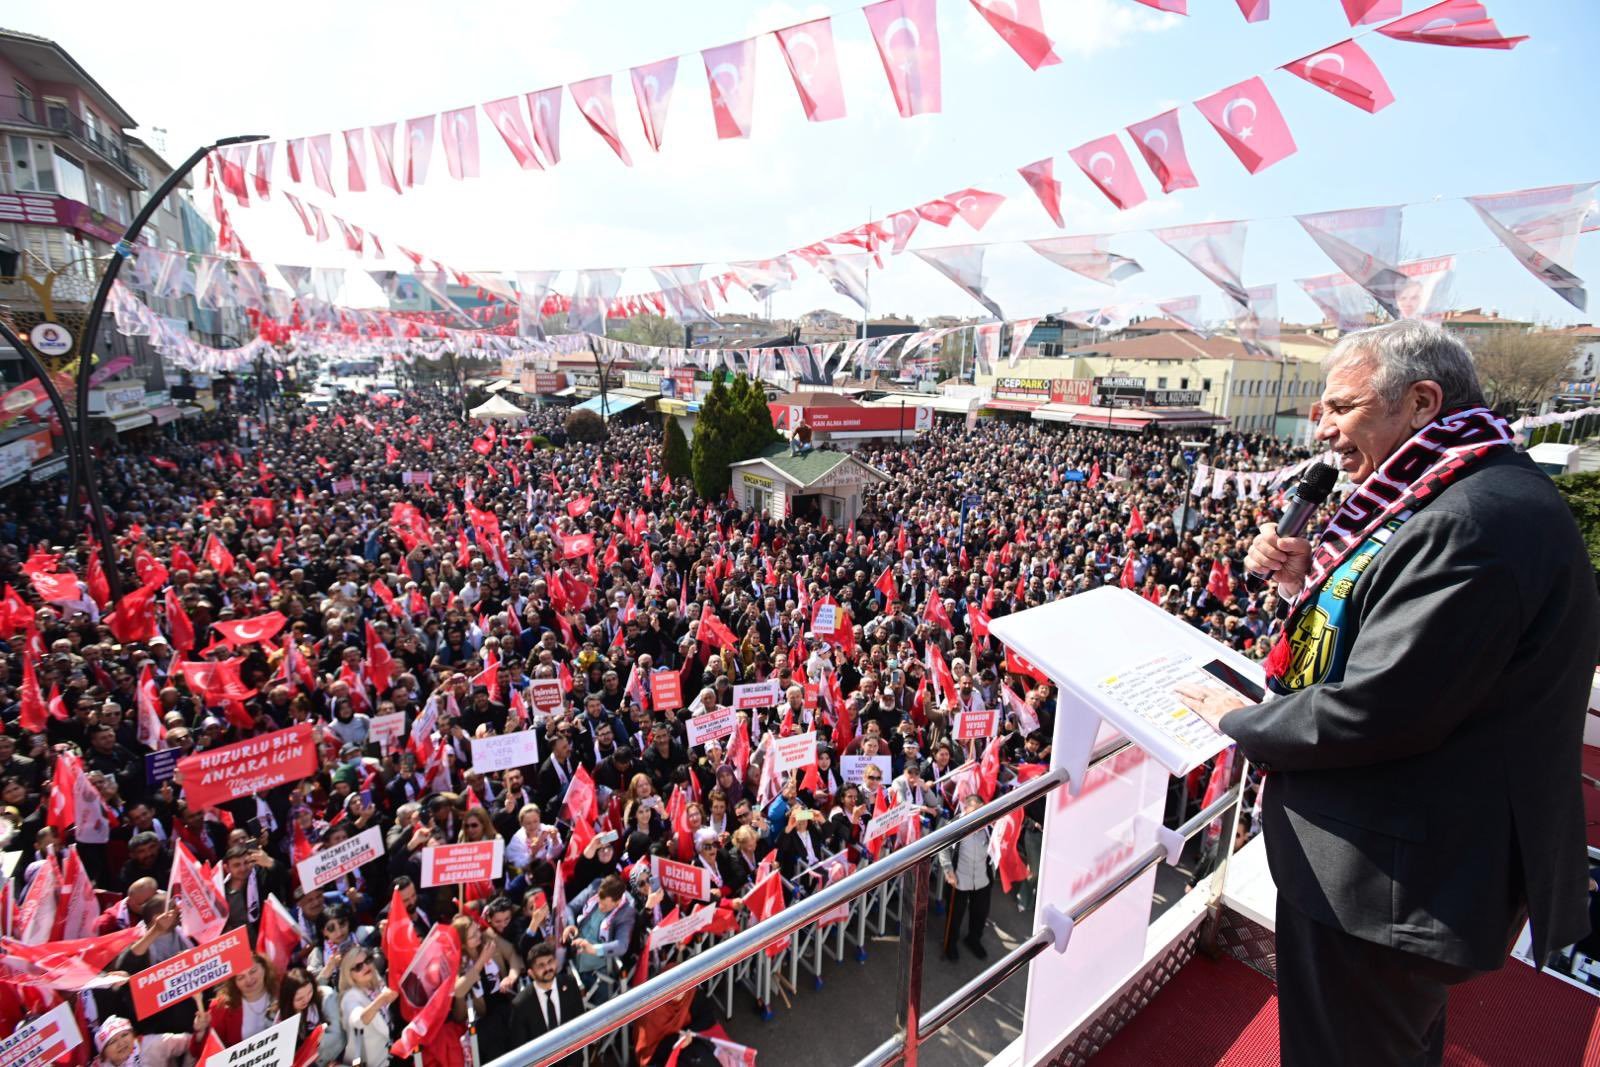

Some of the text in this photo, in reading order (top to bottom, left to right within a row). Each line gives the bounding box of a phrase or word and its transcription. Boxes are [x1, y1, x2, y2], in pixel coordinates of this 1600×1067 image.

[201, 740, 270, 769] HUZURLU
[273, 732, 299, 748] BİR
[201, 756, 269, 786] ANKARA
[314, 843, 370, 875] ÖNCÜ OLACAK
[320, 837, 361, 862] HİZMETTE
[662, 876, 699, 896] VEYSEL
[665, 864, 695, 883] BİZİM
[138, 935, 240, 989] PARSEL PARSEL
[169, 958, 219, 988] EKİYORUZ
[229, 1032, 279, 1063] Ankara
